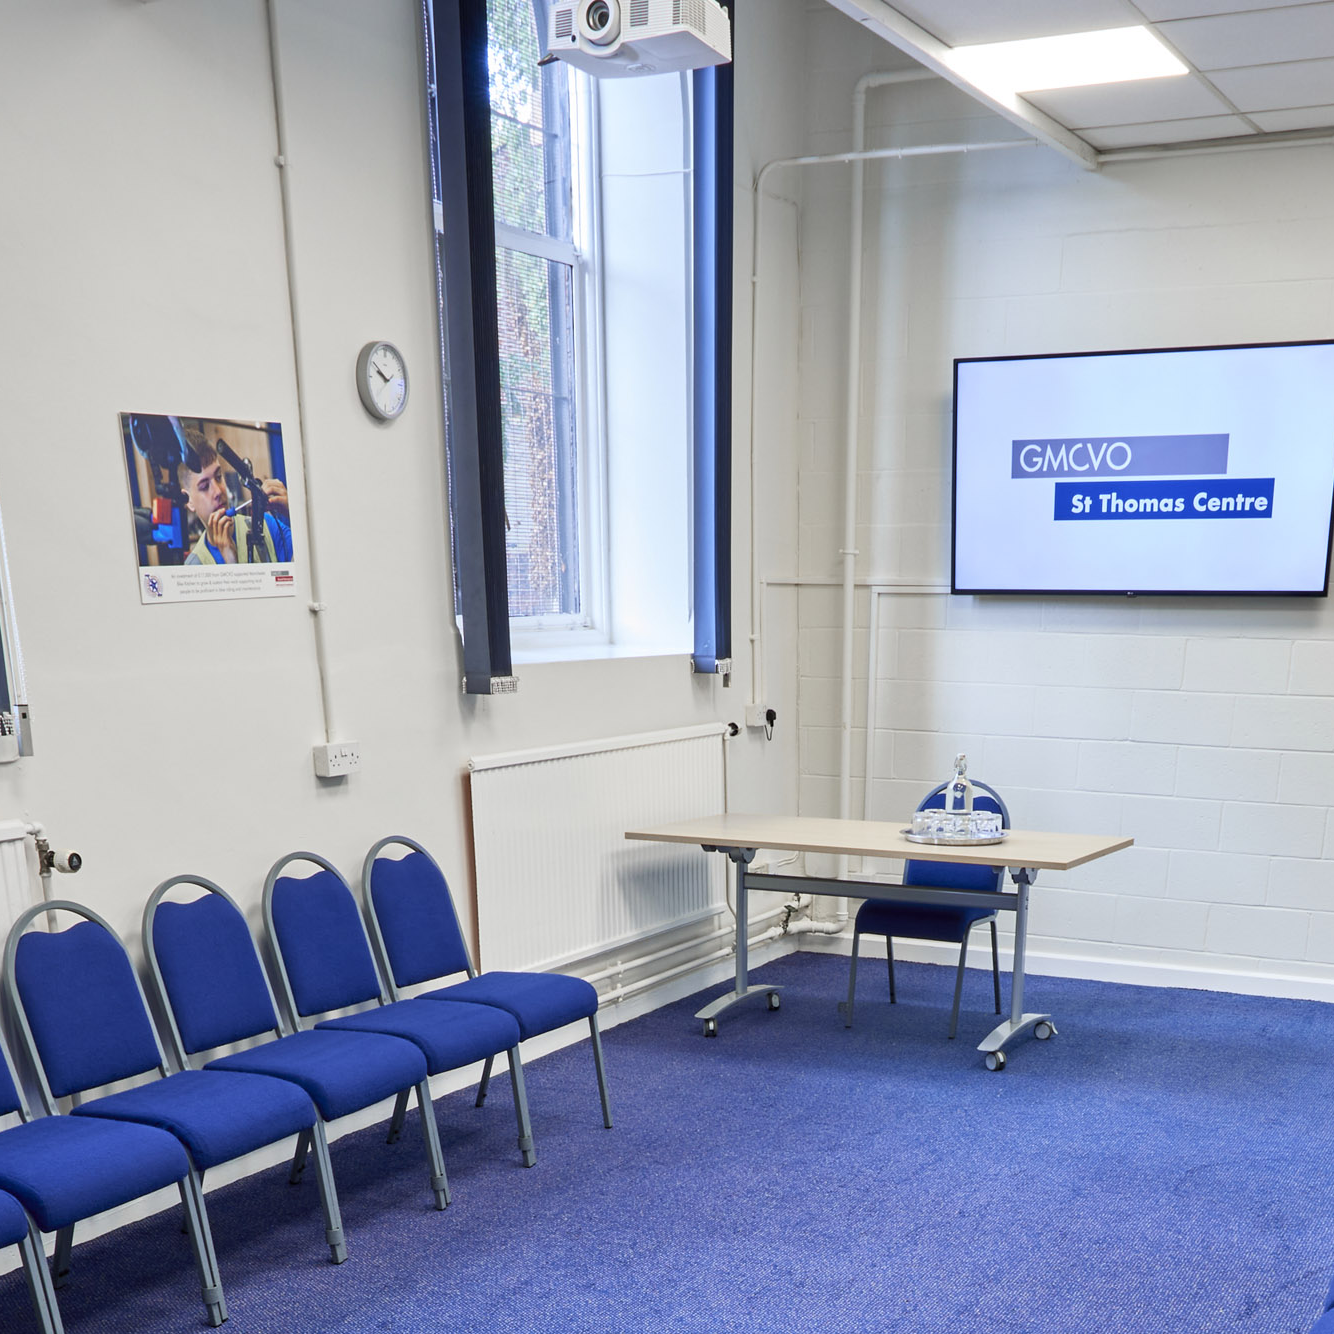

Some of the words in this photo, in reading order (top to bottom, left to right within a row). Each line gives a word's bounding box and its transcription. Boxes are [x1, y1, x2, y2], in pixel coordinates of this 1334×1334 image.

[1020, 442, 1132, 472] GMCVO
[1071, 494, 1092, 513] St
[1099, 492, 1185, 513] Thomas
[1193, 492, 1268, 511] Centre
